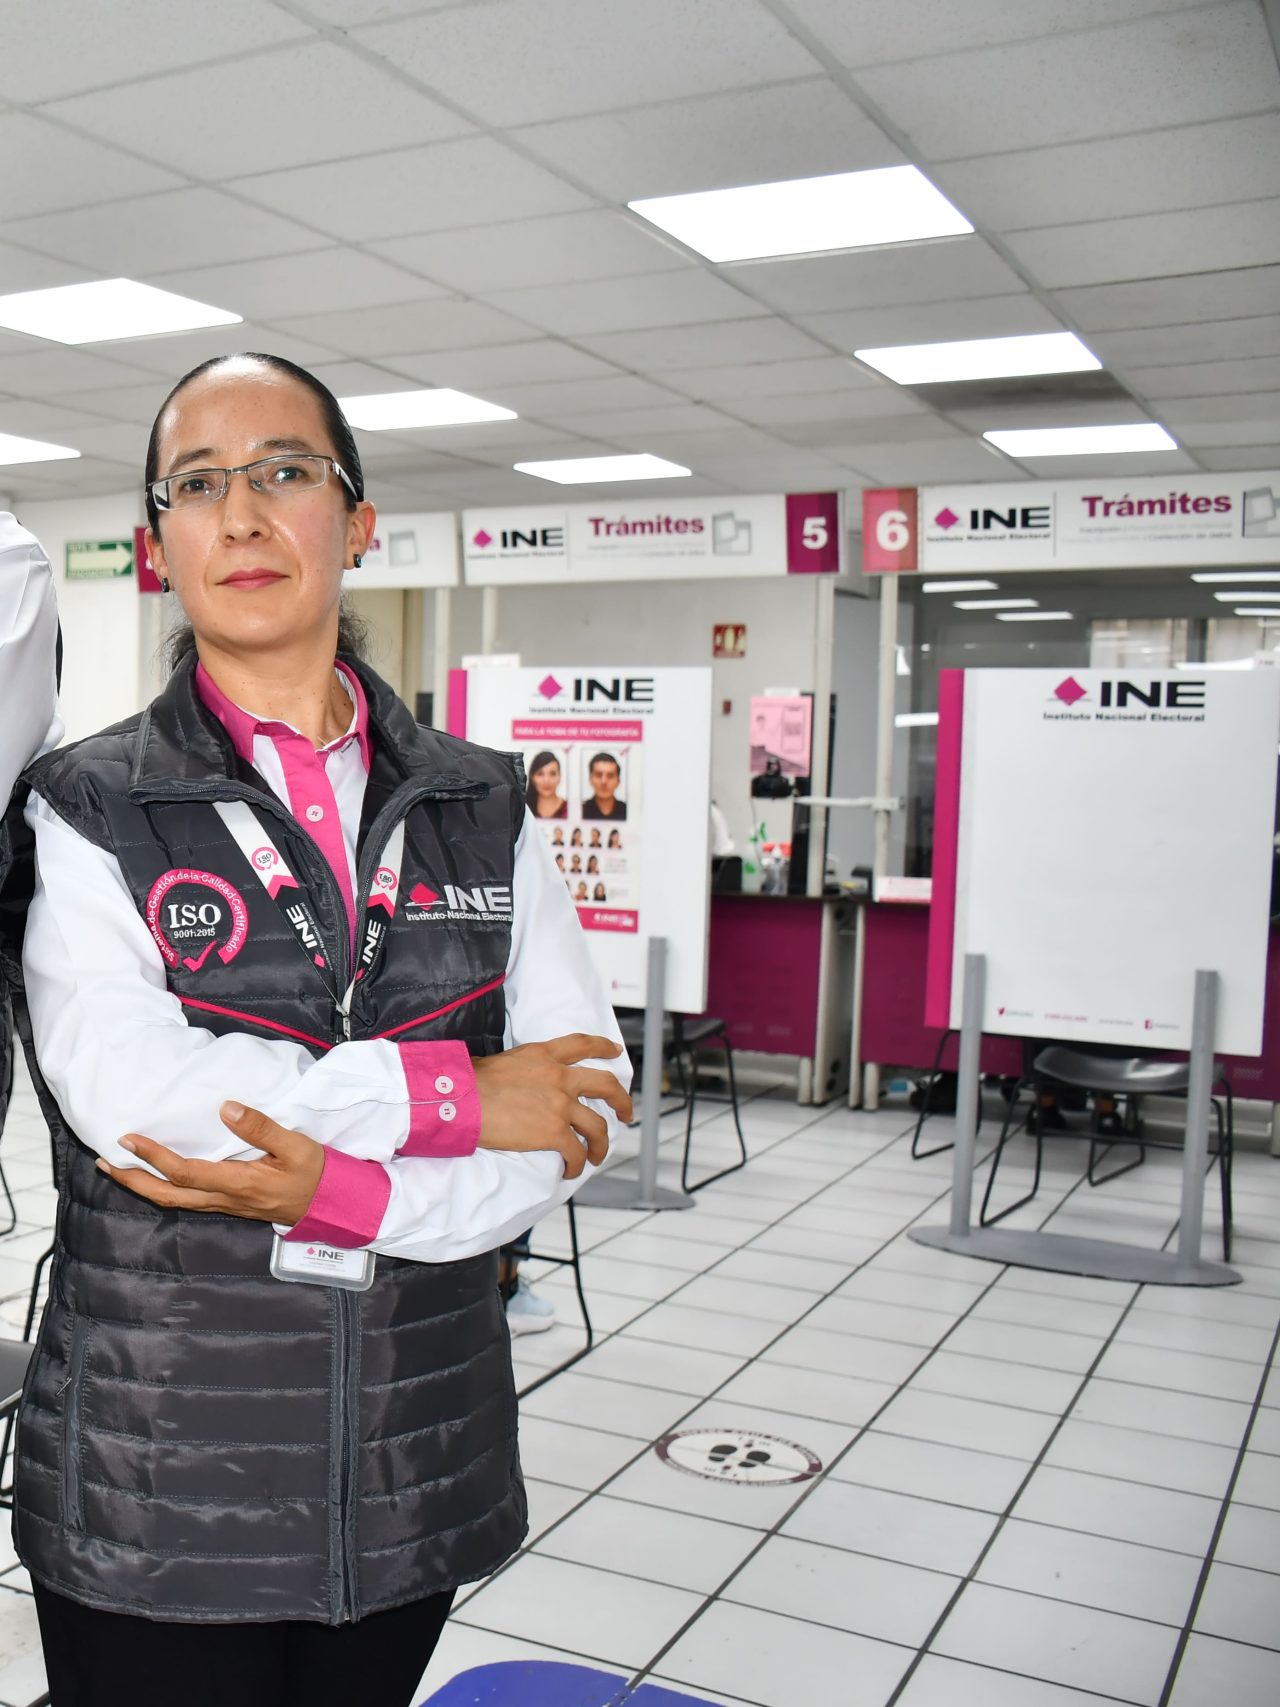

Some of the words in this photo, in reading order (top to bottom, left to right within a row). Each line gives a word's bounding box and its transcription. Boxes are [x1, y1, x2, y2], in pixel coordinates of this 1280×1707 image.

[1081, 492, 1233, 518] Trámites
[588, 514, 705, 538] Trámites
[875, 509, 910, 551] 6
[970, 506, 1050, 530] INE
[500, 527, 564, 549] INE
[801, 516, 829, 550] 5
[574, 678, 654, 702] INE
[1101, 681, 1206, 708] INE
[1095, 713, 1147, 721] Nacional
[1150, 713, 1206, 722] Electoral
[257, 853, 272, 864] ISO
[177, 872, 188, 880] de
[190, 872, 199, 880] la
[201, 874, 236, 899] Calidad
[149, 873, 176, 908] Gestión
[443, 884, 512, 912] INE
[147, 911, 156, 923] de
[168, 904, 221, 929] ISO
[225, 898, 246, 953] Certificado
[286, 904, 318, 949] INE
[406, 910, 445, 921] Instituto
[446, 910, 480, 920] Nacional
[173, 927, 216, 939] 9001:2015
[362, 919, 382, 964] INE
[318, 1248, 345, 1261] INE
